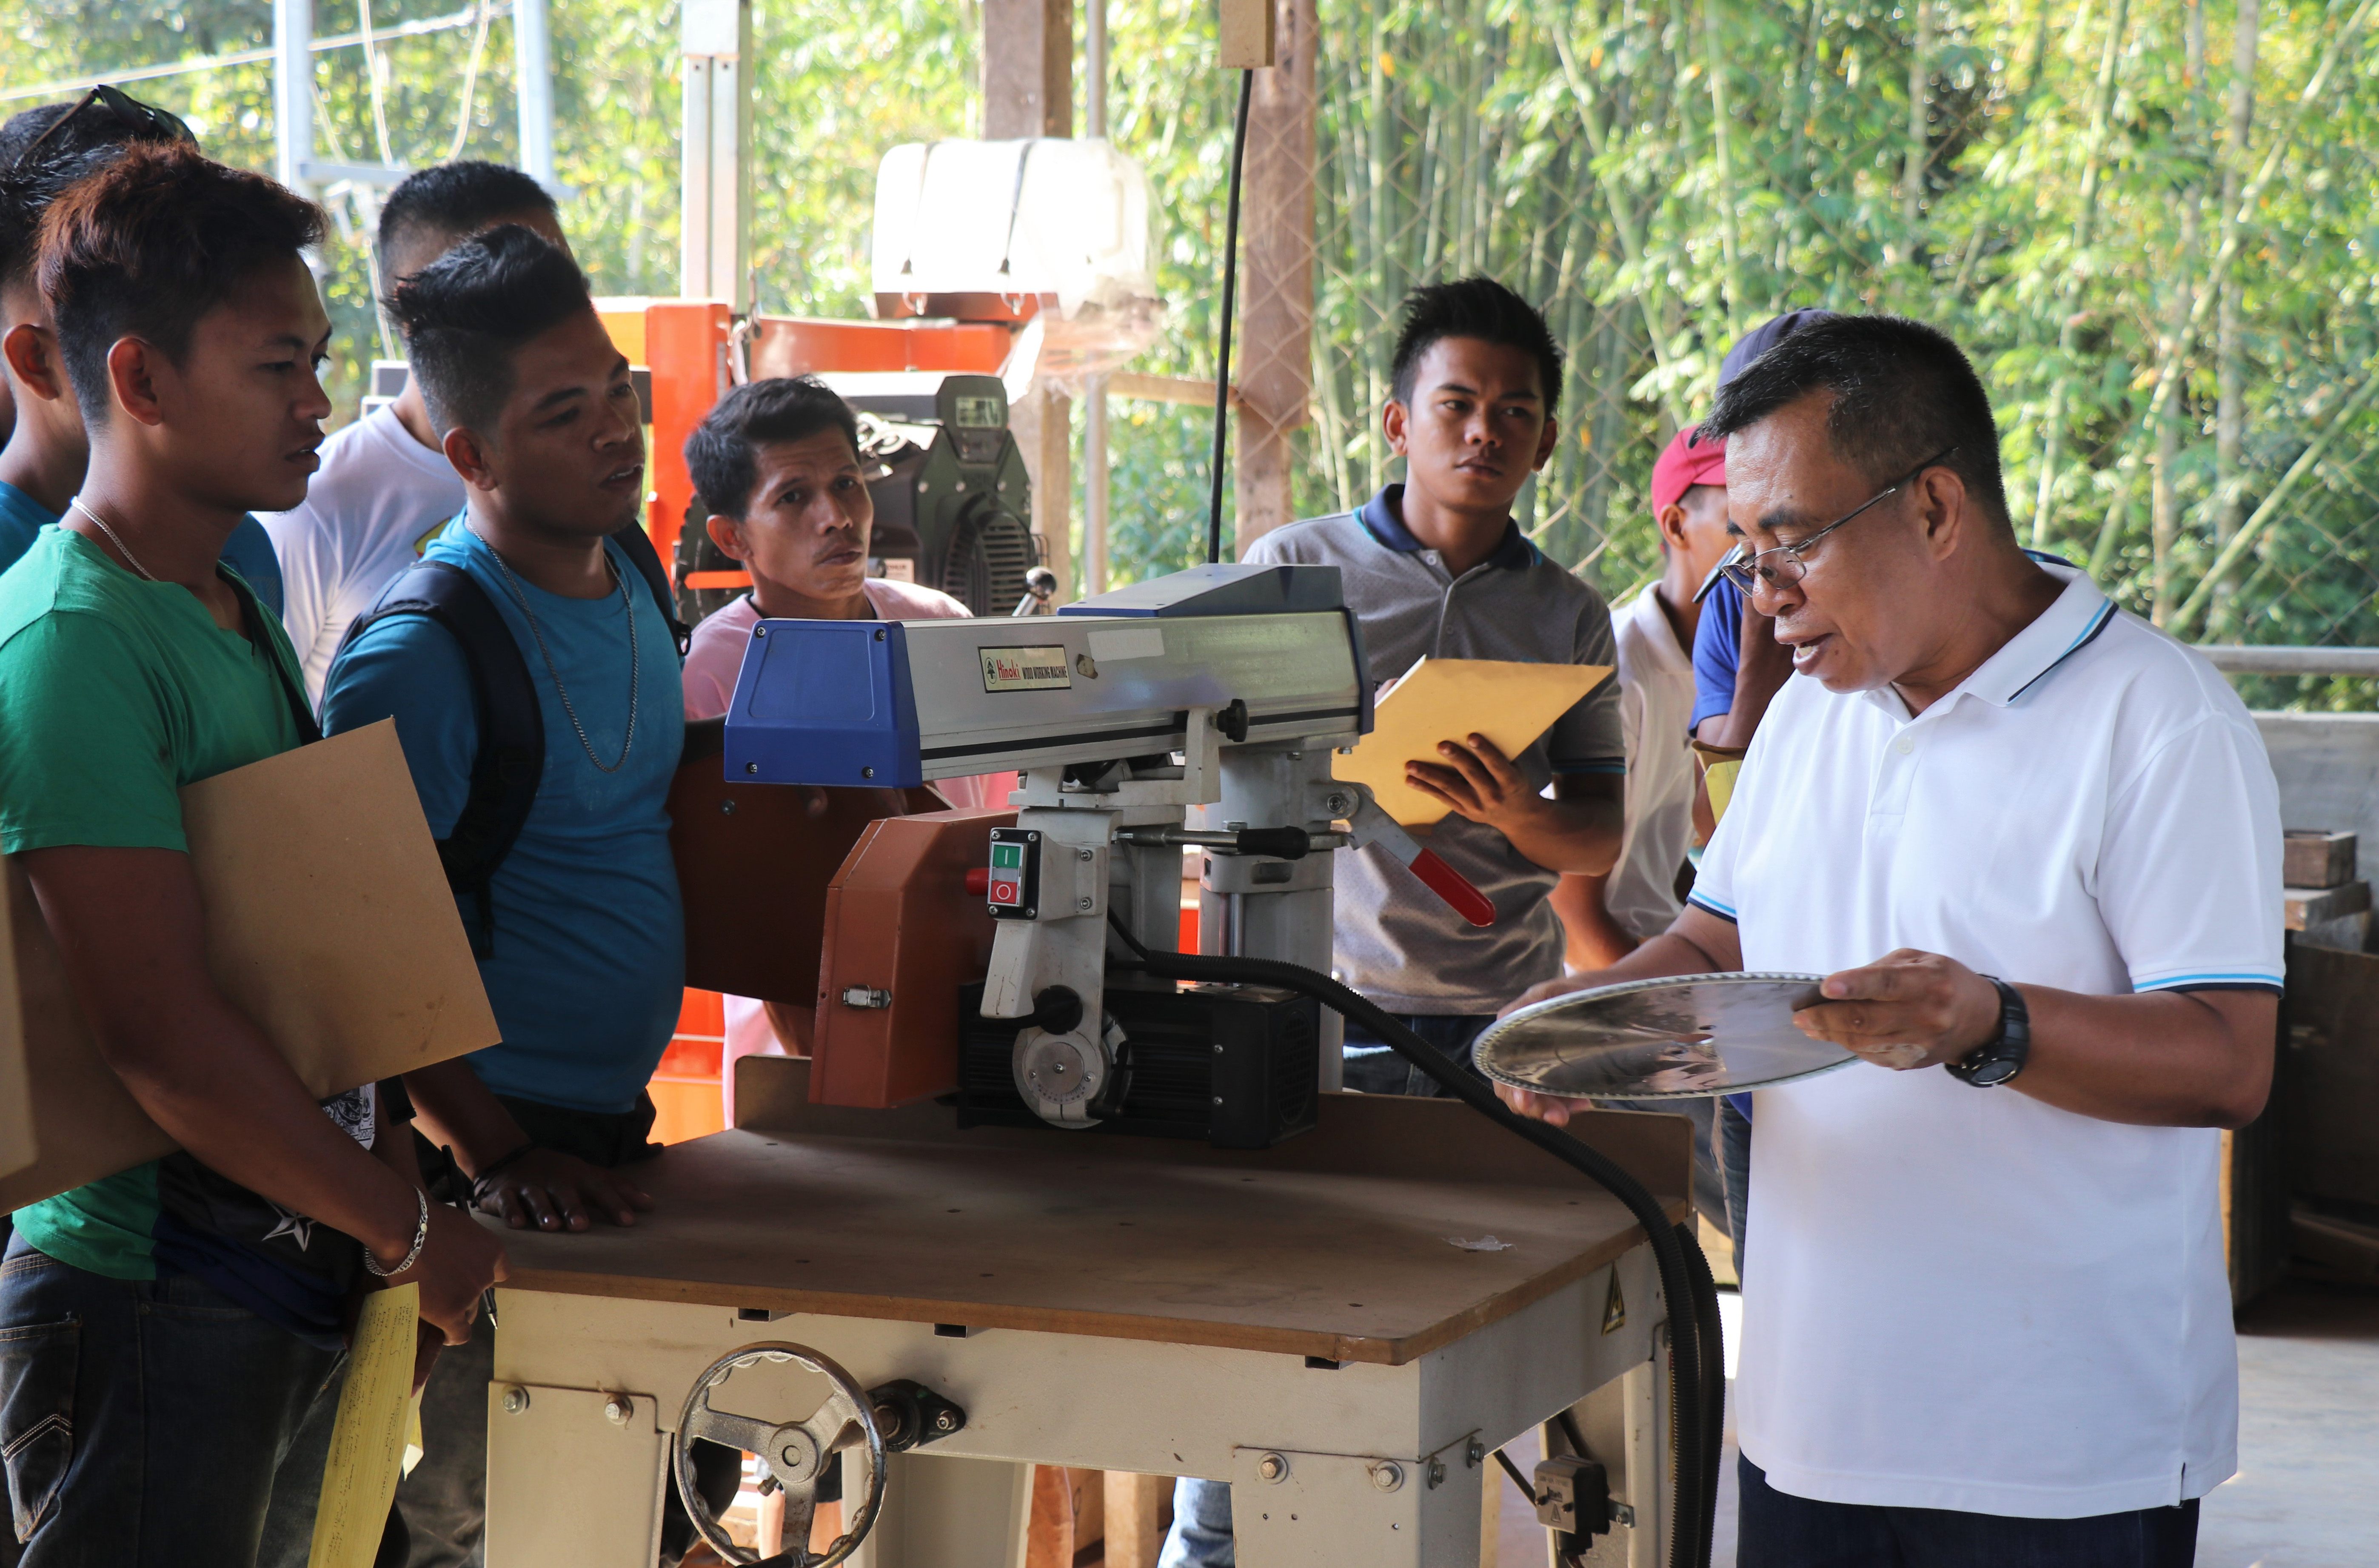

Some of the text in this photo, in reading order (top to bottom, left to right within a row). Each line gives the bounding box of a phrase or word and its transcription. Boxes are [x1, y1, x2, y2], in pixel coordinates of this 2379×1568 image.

[996, 659, 1067, 679] Hinoki WOOD WORKING MACHINE
